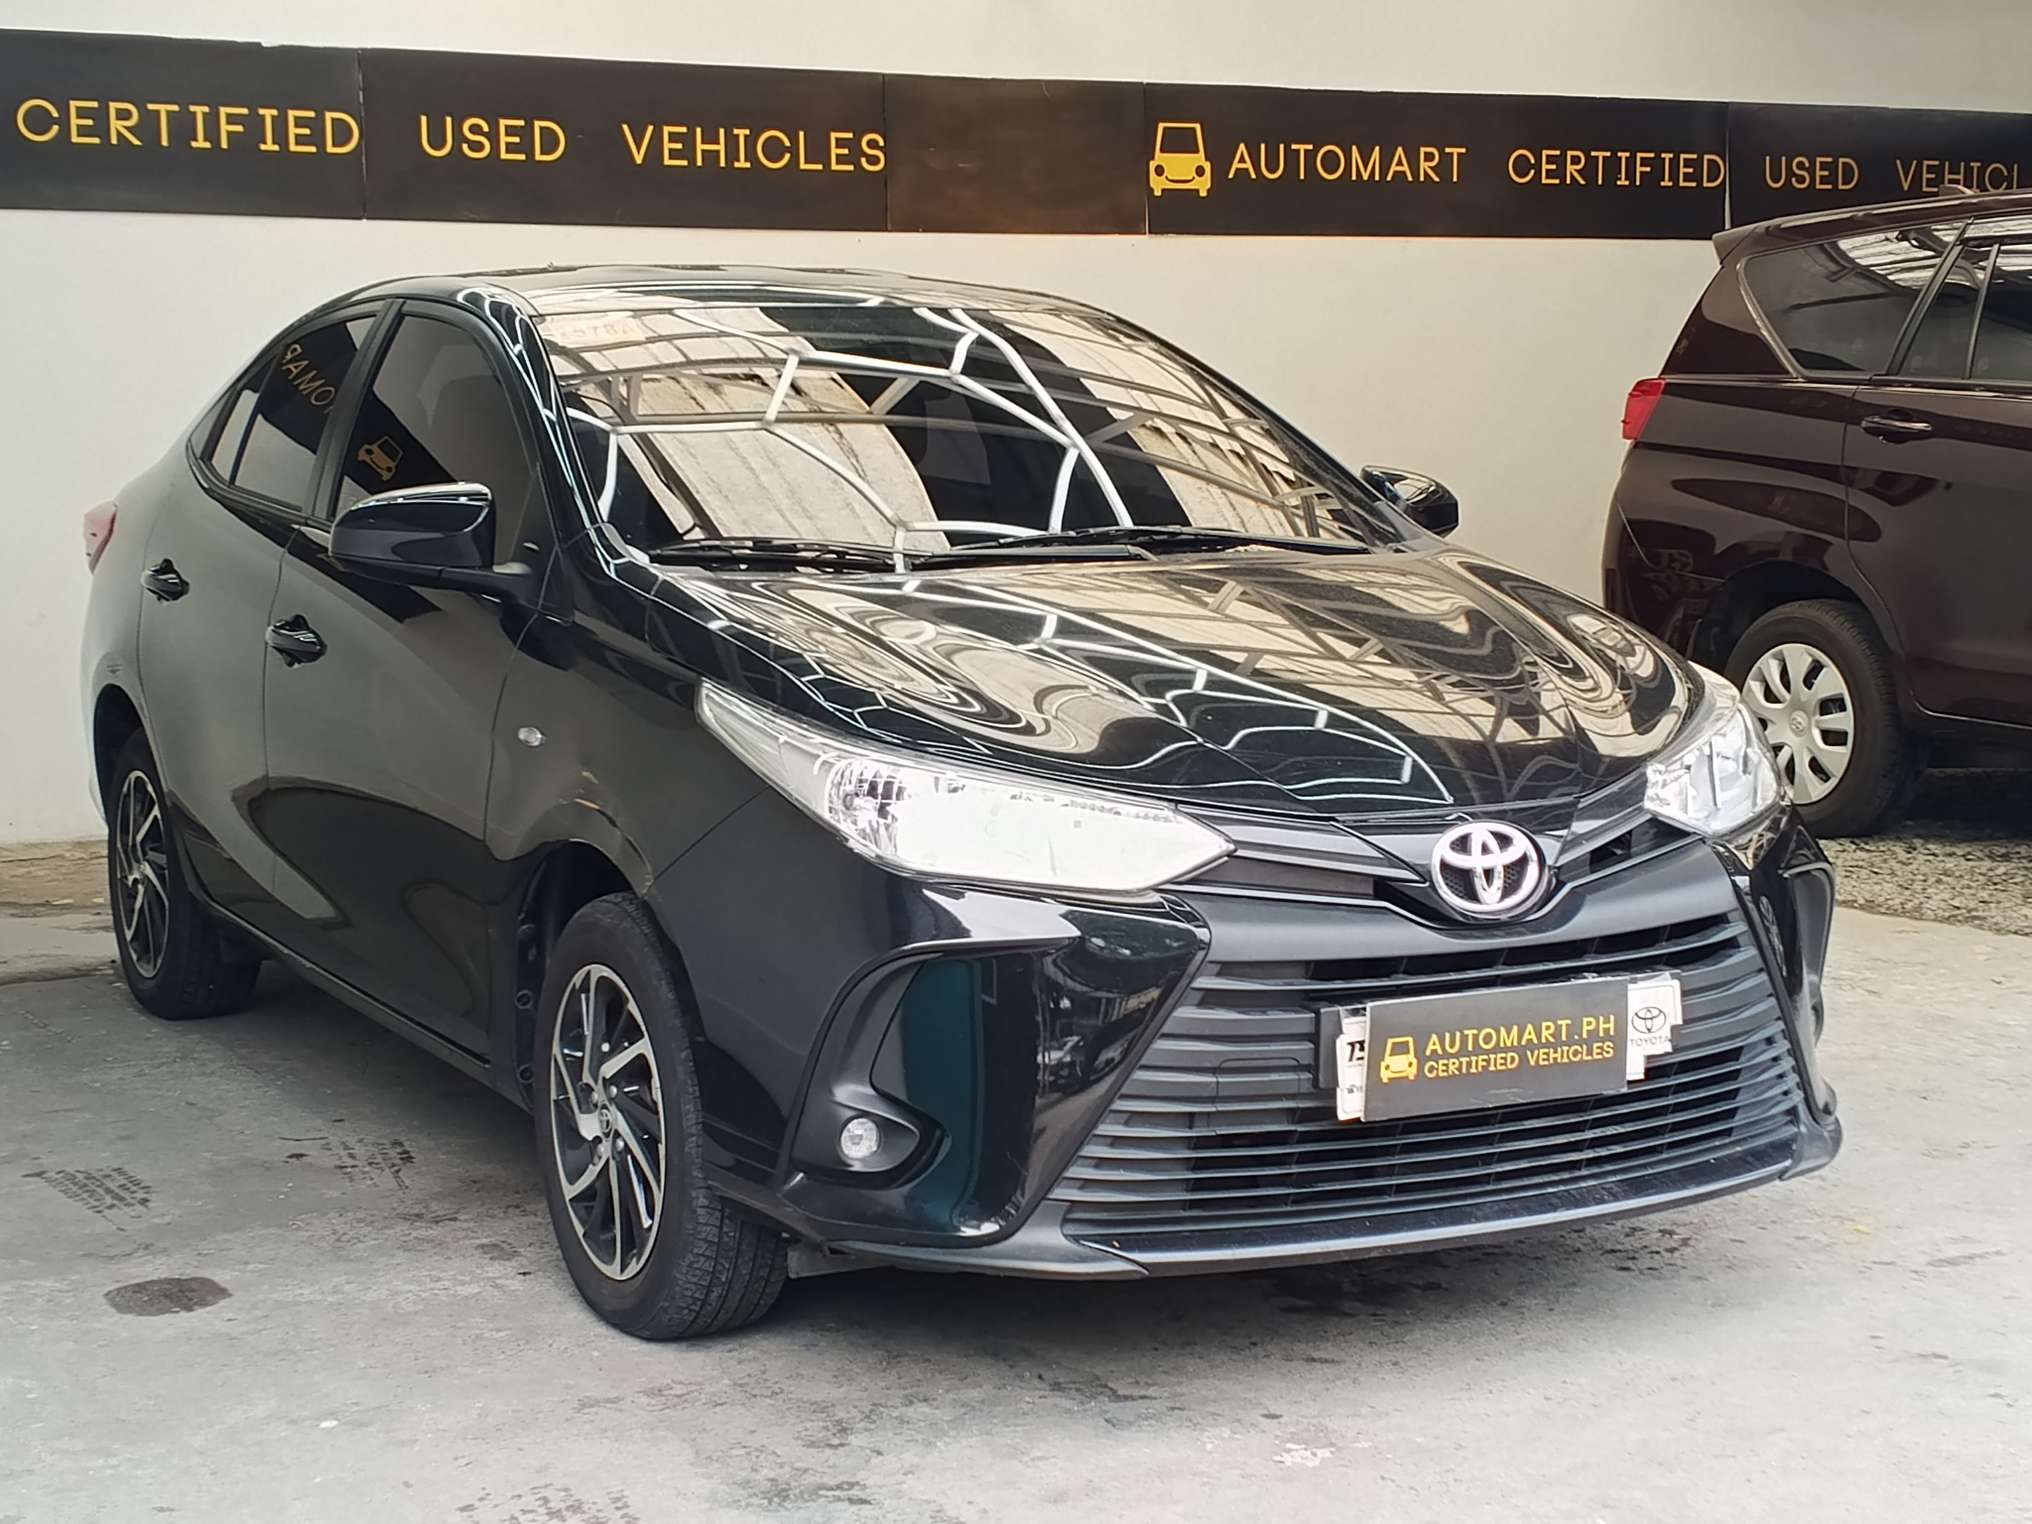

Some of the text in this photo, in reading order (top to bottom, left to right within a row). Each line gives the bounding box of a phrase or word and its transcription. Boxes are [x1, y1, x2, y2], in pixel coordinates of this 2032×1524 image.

[16, 98, 886, 172] CERTIFIED USED VEHICLES
[1227, 143, 1467, 184] AUTOMART
[1508, 149, 1725, 188] CERTIFIED
[1765, 156, 1859, 190] USED
[1425, 1014, 1616, 1057] AUTOMART.PH
[1629, 1035, 1671, 1048] TOYOTA
[1424, 1041, 1616, 1079] CERTIFIED VEHICLES
